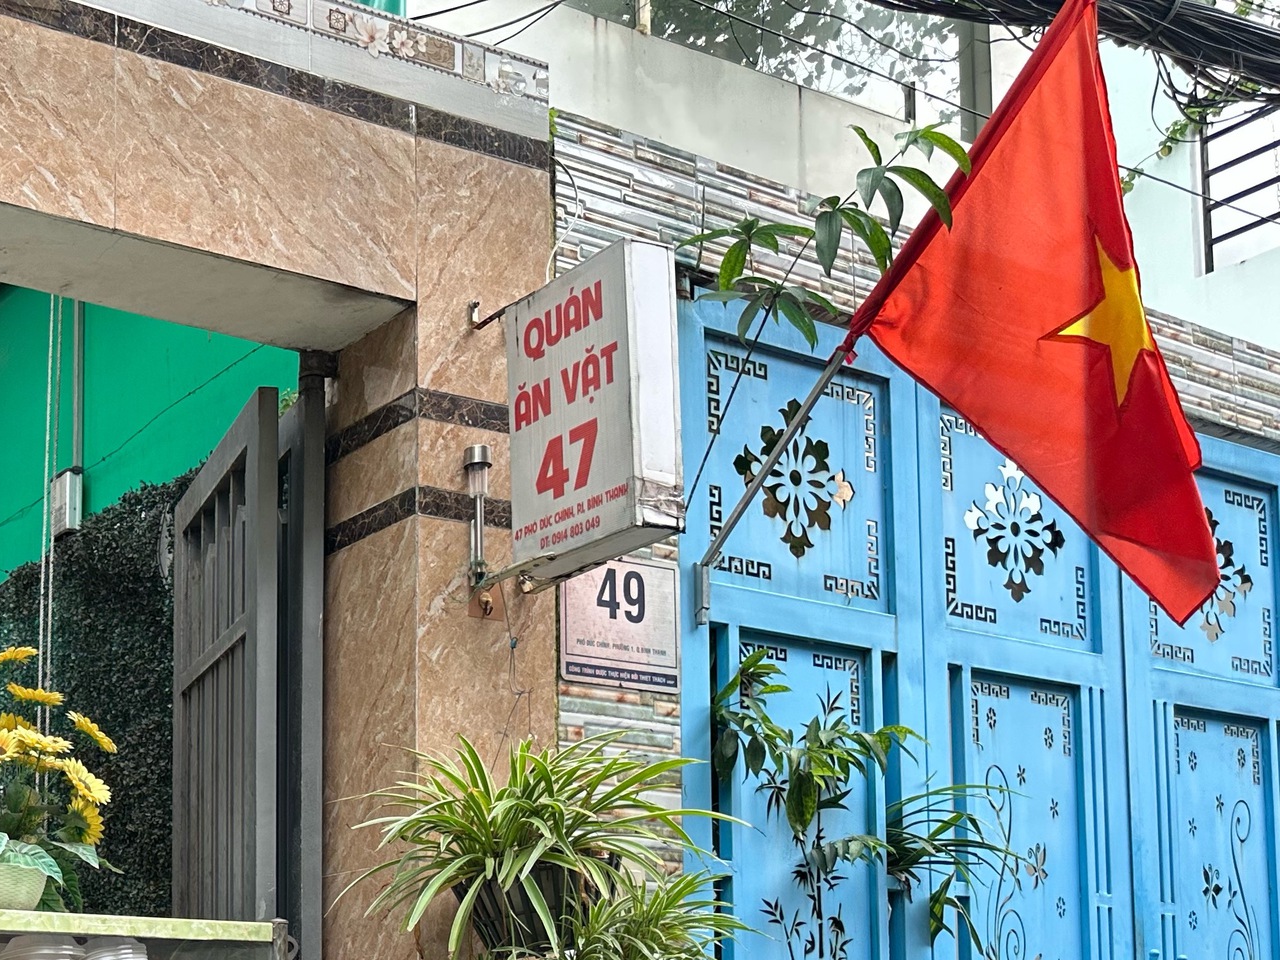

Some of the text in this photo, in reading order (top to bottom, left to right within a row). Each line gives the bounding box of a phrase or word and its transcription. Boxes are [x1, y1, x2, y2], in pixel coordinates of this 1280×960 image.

[523, 279, 603, 362] QUÁN
[515, 341, 618, 432] ĂN VẶT
[535, 417, 598, 500] 47
[514, 528, 523, 542] 47
[551, 530, 568, 546] 0914
[570, 522, 584, 539] 803
[585, 515, 601, 532] 049
[596, 567, 646, 624] 49
